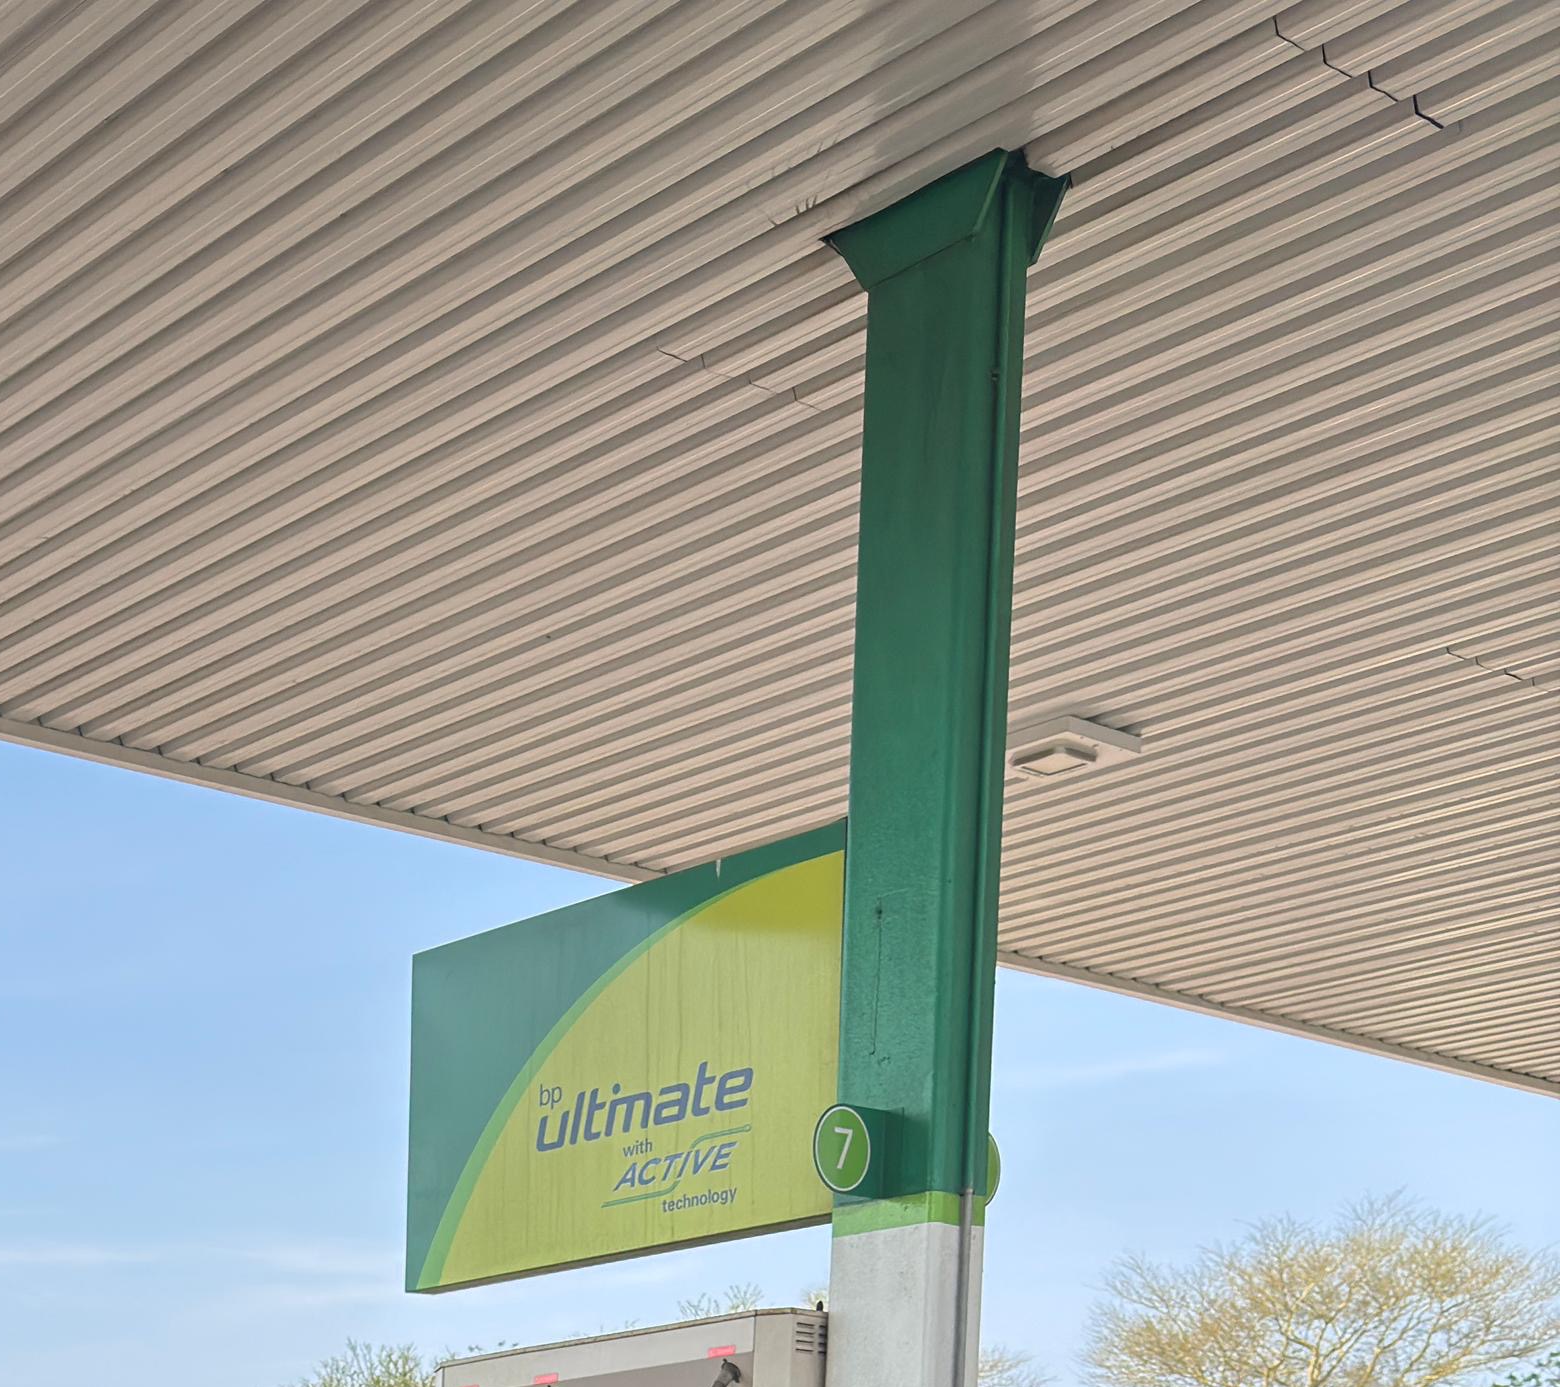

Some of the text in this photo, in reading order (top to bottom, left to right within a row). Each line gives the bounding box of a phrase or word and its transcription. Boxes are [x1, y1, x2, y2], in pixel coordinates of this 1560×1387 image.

[536, 1060, 754, 1153] ultimate
[539, 1084, 563, 1110] bp
[622, 1138, 653, 1158] with
[833, 1126, 854, 1170] 7
[612, 1140, 739, 1193] ACTIVE
[662, 1187, 738, 1213] technology
